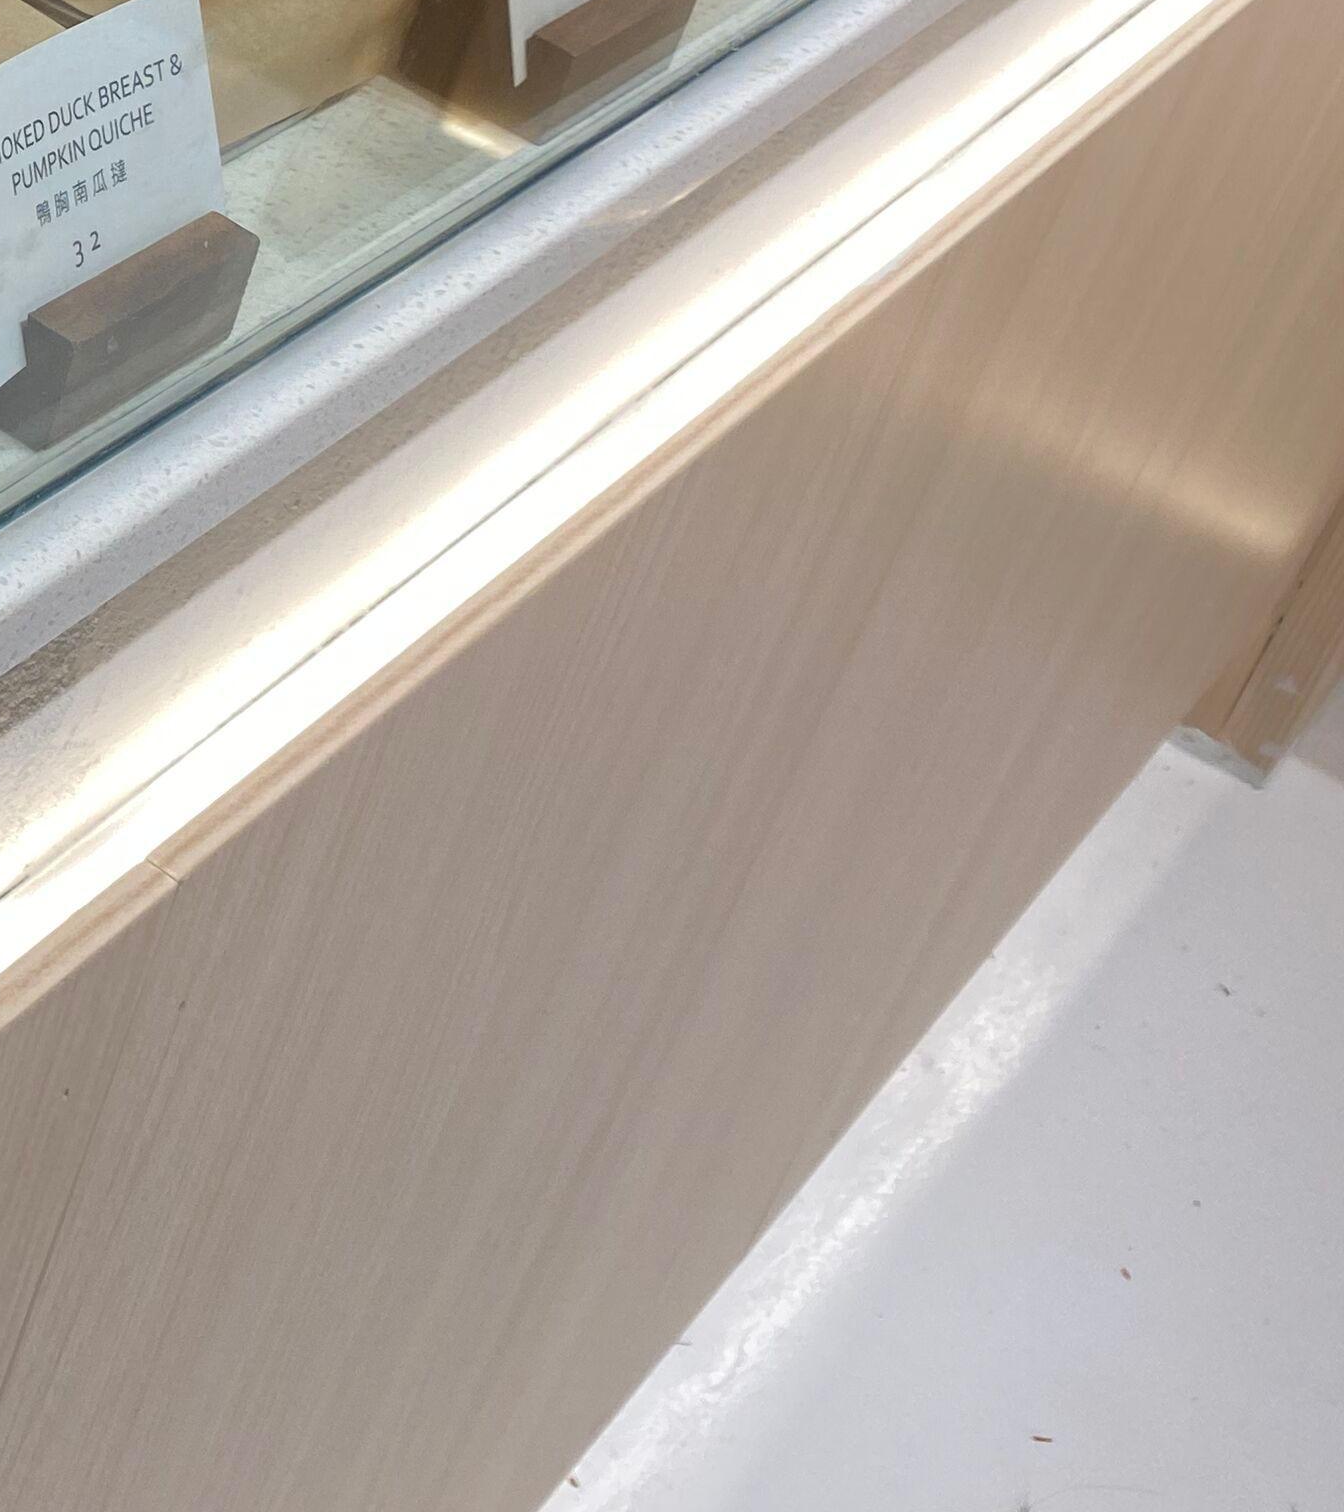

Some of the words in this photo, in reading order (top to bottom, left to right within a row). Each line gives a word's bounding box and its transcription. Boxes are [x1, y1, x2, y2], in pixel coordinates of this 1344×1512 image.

[48, 91, 96, 134] DUCK
[98, 59, 165, 109] BREAST
[169, 53, 183, 77] &
[11, 135, 87, 197] PUMPKIN
[88, 102, 155, 152] QUICHE
